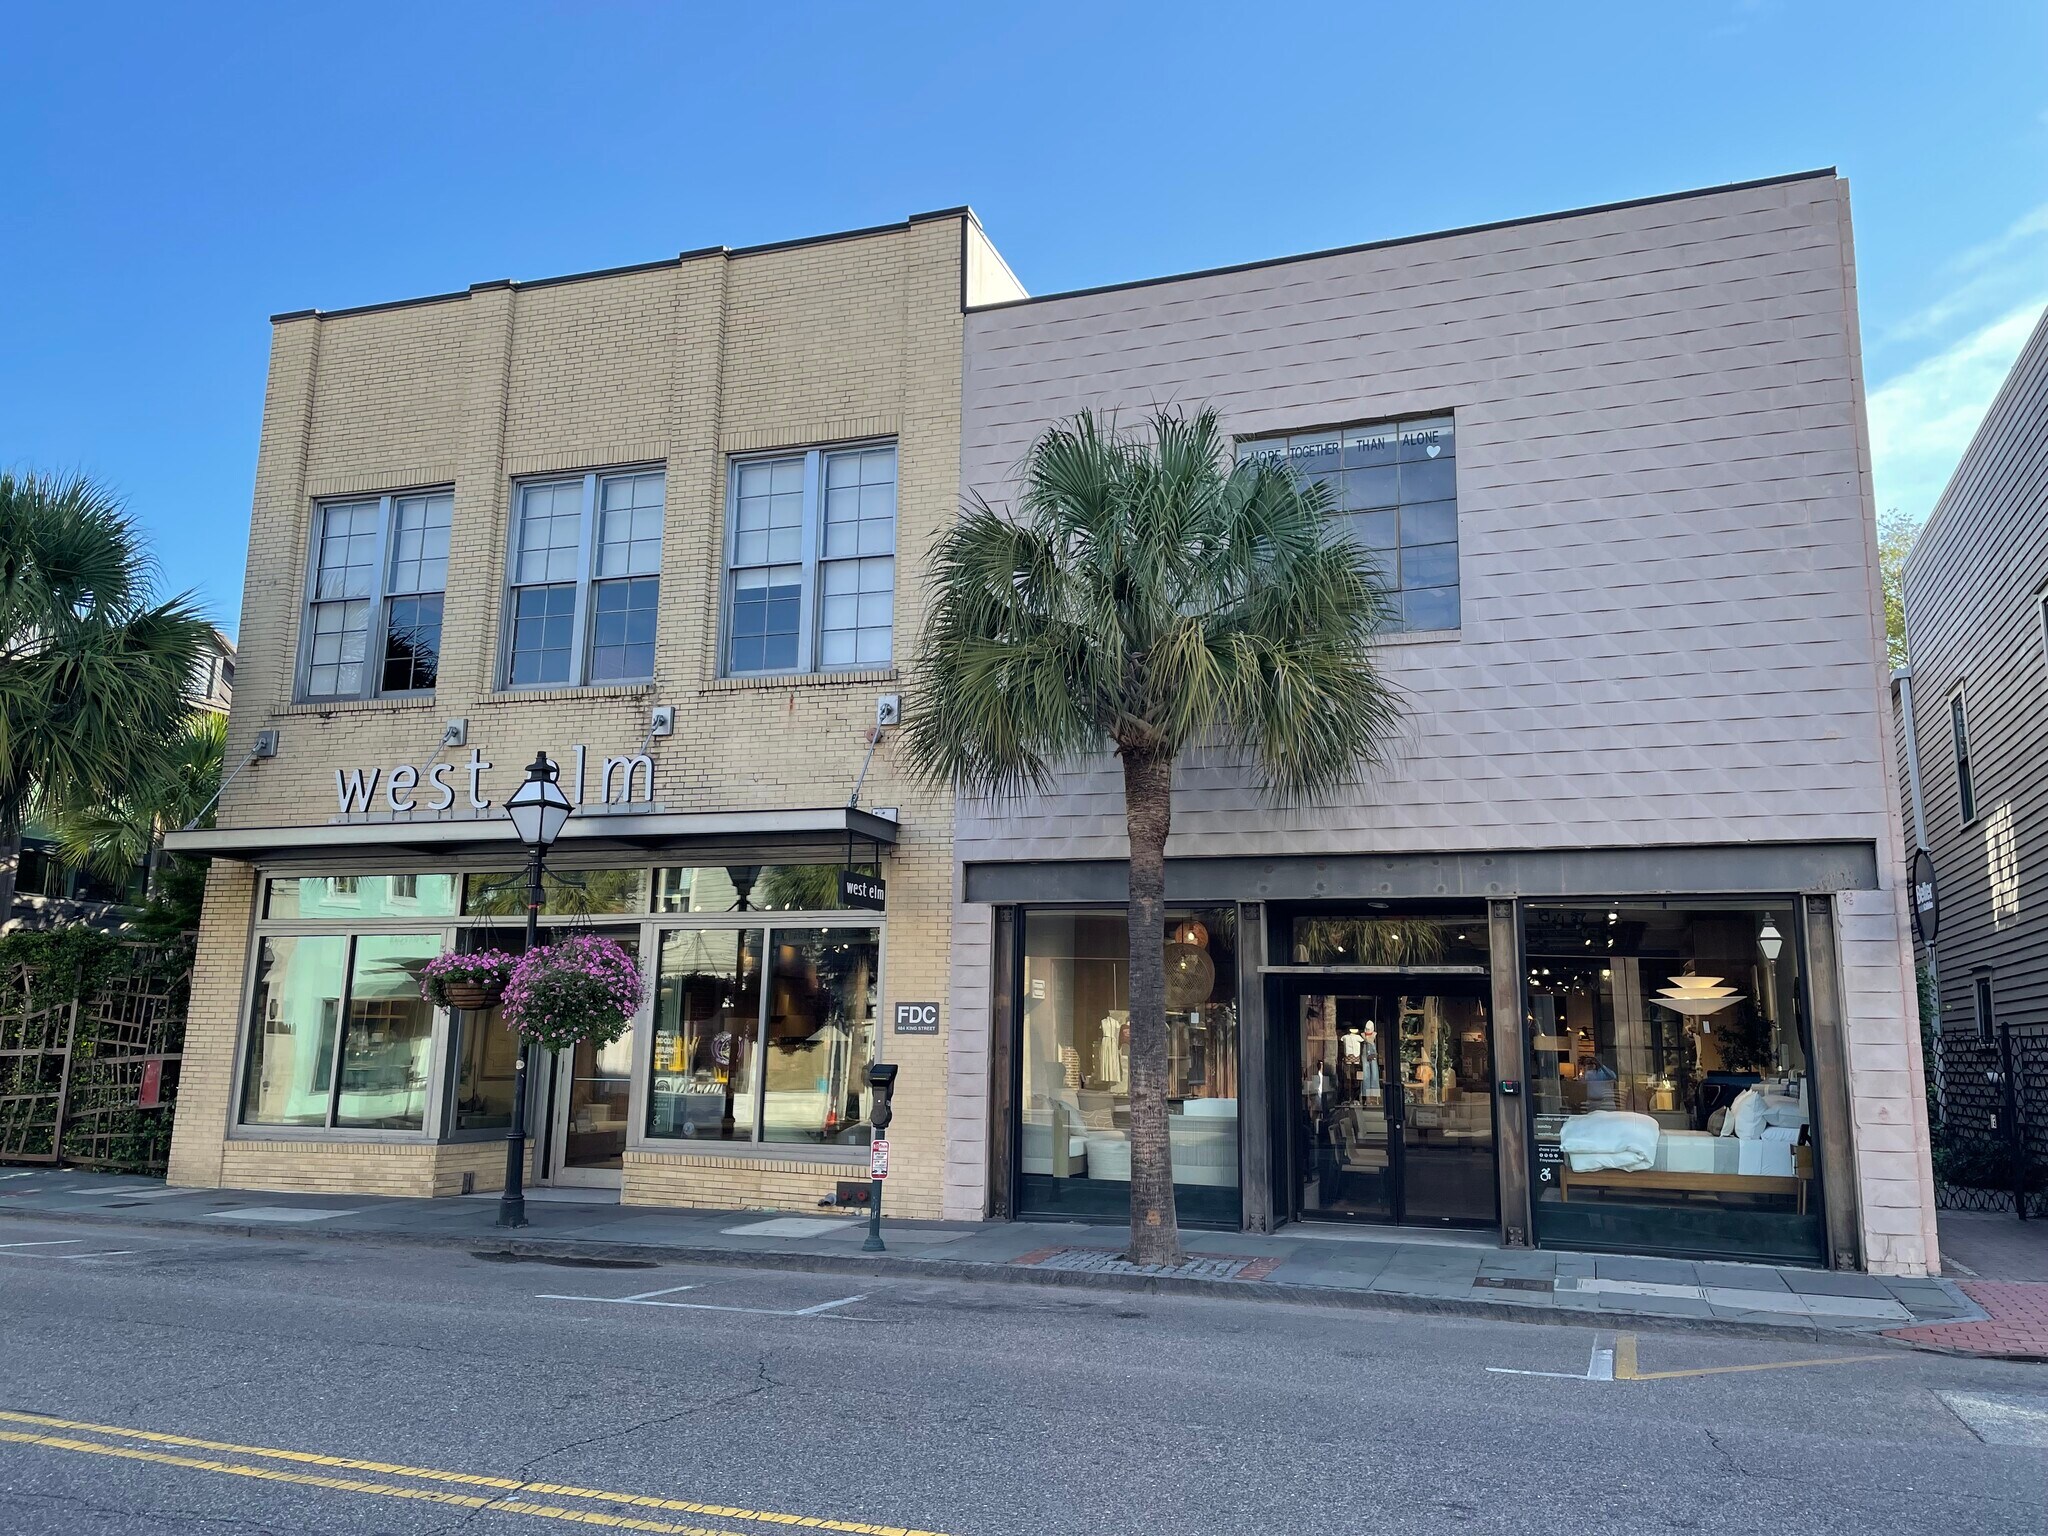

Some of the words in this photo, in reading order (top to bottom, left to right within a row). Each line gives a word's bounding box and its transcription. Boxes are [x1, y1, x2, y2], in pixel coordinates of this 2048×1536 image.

[1290, 442, 1339, 459] TOGETHER
[1356, 437, 1385, 452] THAN
[1402, 430, 1439, 446] ALONE
[335, 748, 493, 813] west
[846, 882, 867, 897] west
[869, 884, 885, 900] elm
[897, 1005, 936, 1024] FDC
